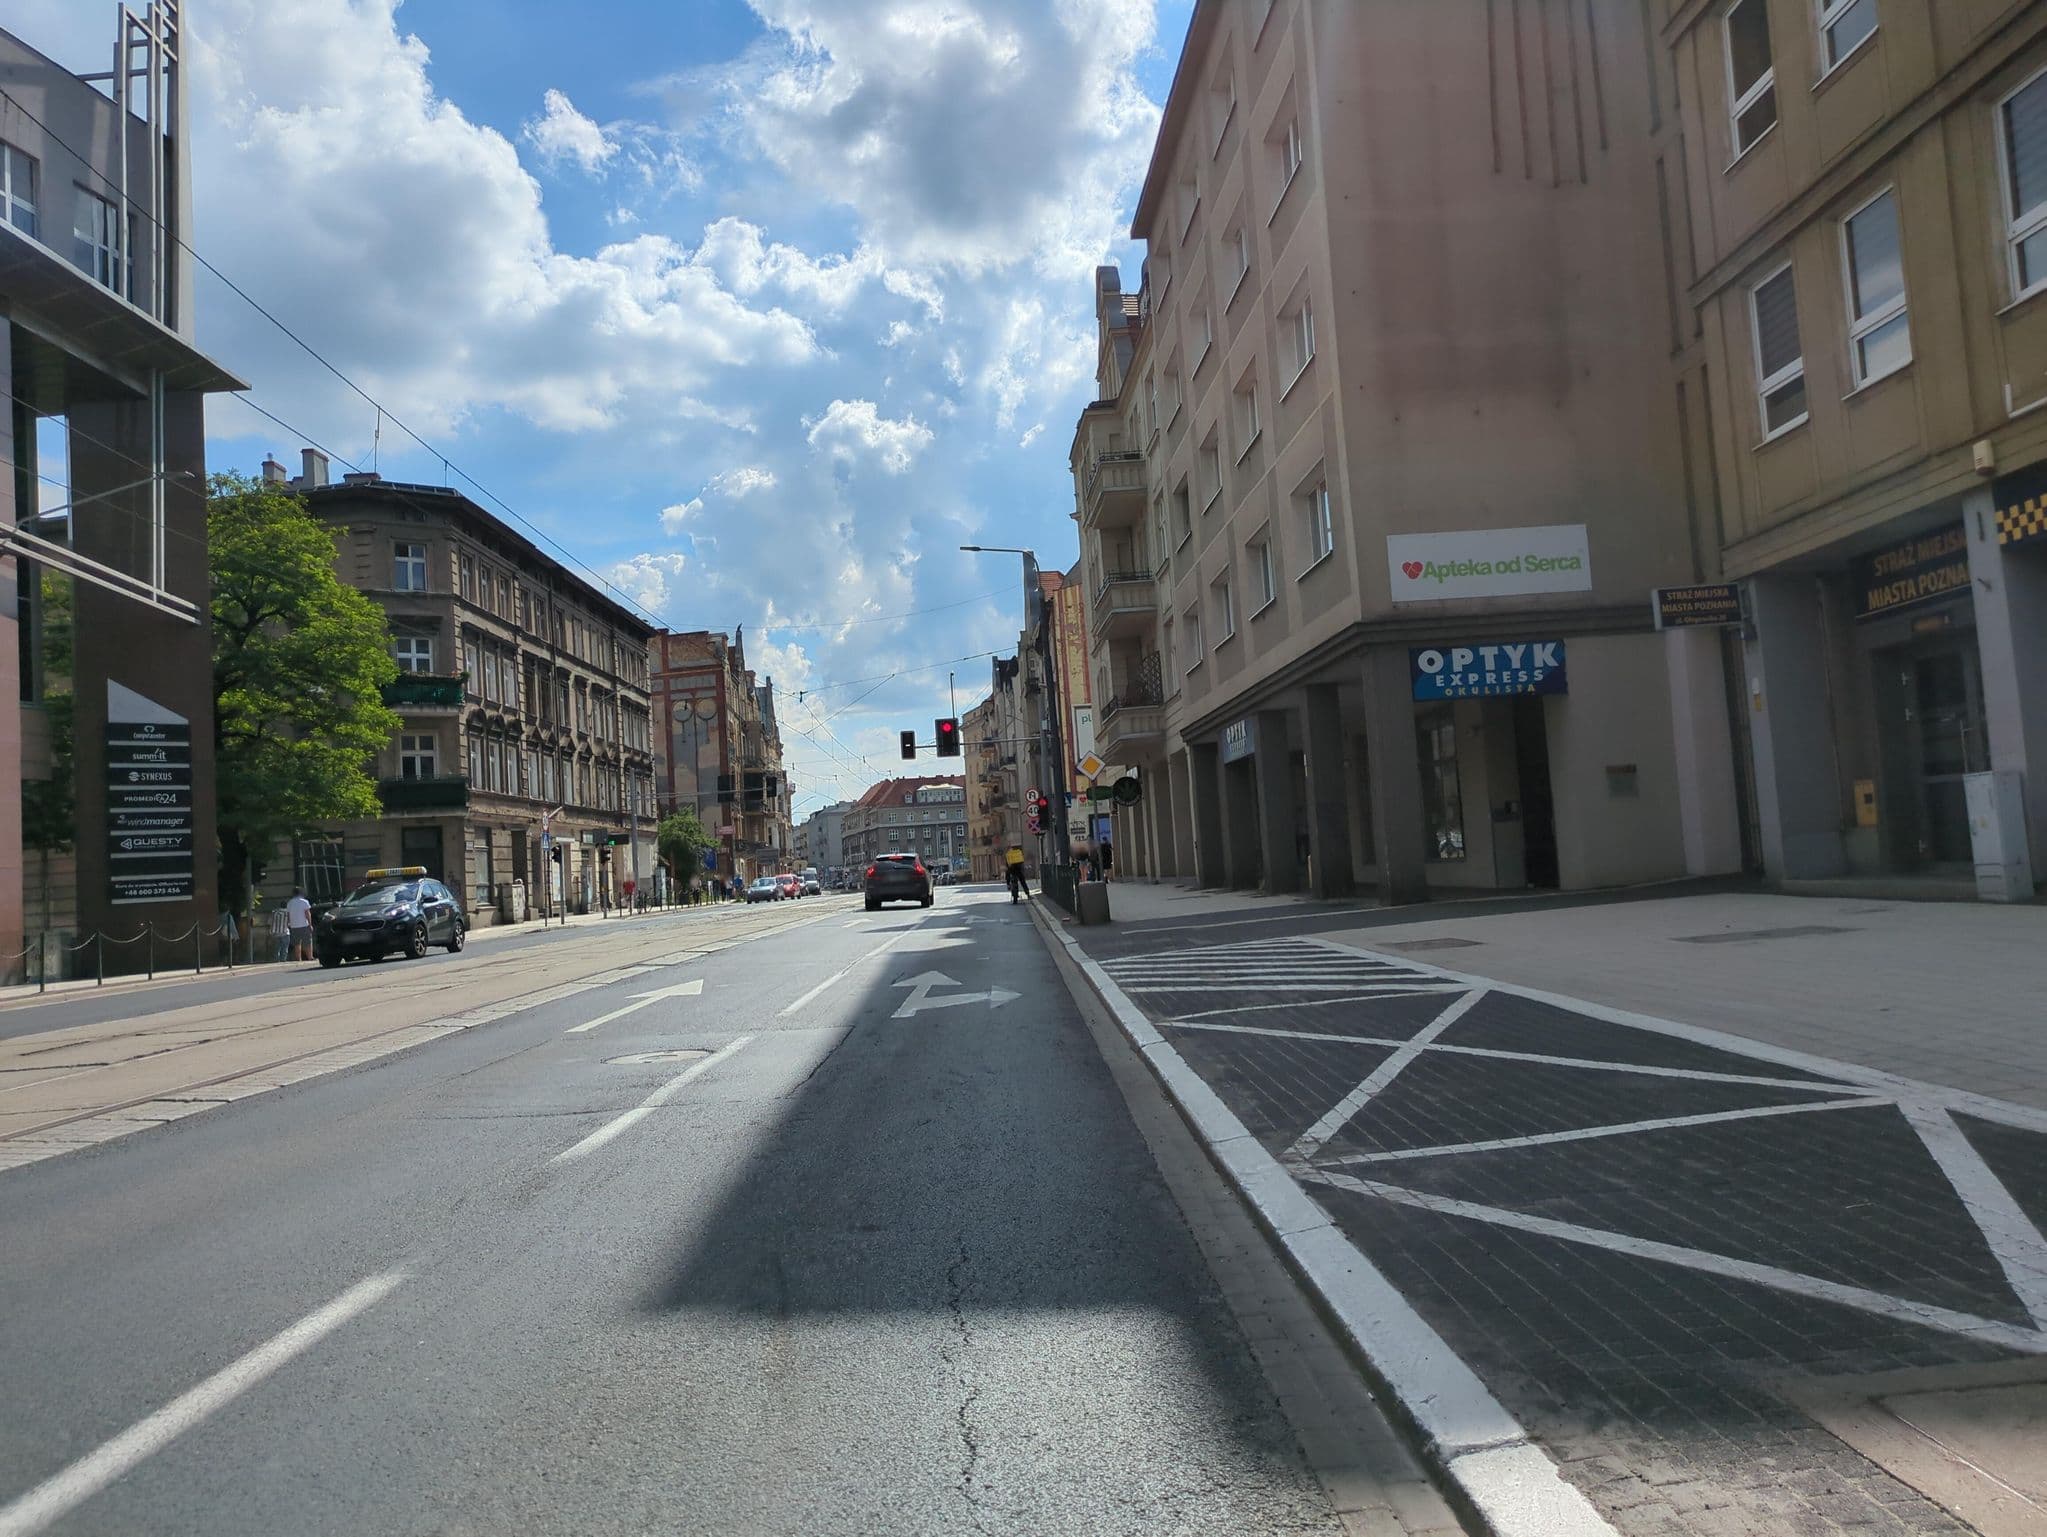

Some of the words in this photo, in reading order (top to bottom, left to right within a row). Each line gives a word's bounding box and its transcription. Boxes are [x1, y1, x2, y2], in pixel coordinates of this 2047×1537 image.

[1423, 559, 1492, 583] Apteka
[1495, 556, 1521, 574] od
[1524, 555, 1582, 573] Serca
[1867, 578, 1917, 609] MIASTA
[1662, 603, 1693, 613] MIASTA
[1695, 600, 1737, 610] POZNANIA
[1418, 642, 1559, 674] OPTYK
[1436, 669, 1544, 687] EXPRESS
[1445, 684, 1536, 697] OKULISTA
[141, 772, 172, 781] SYNEXUS
[1028, 806, 1039, 815] 40
[128, 818, 184, 828] windmanager
[133, 837, 182, 846] QUESTY
